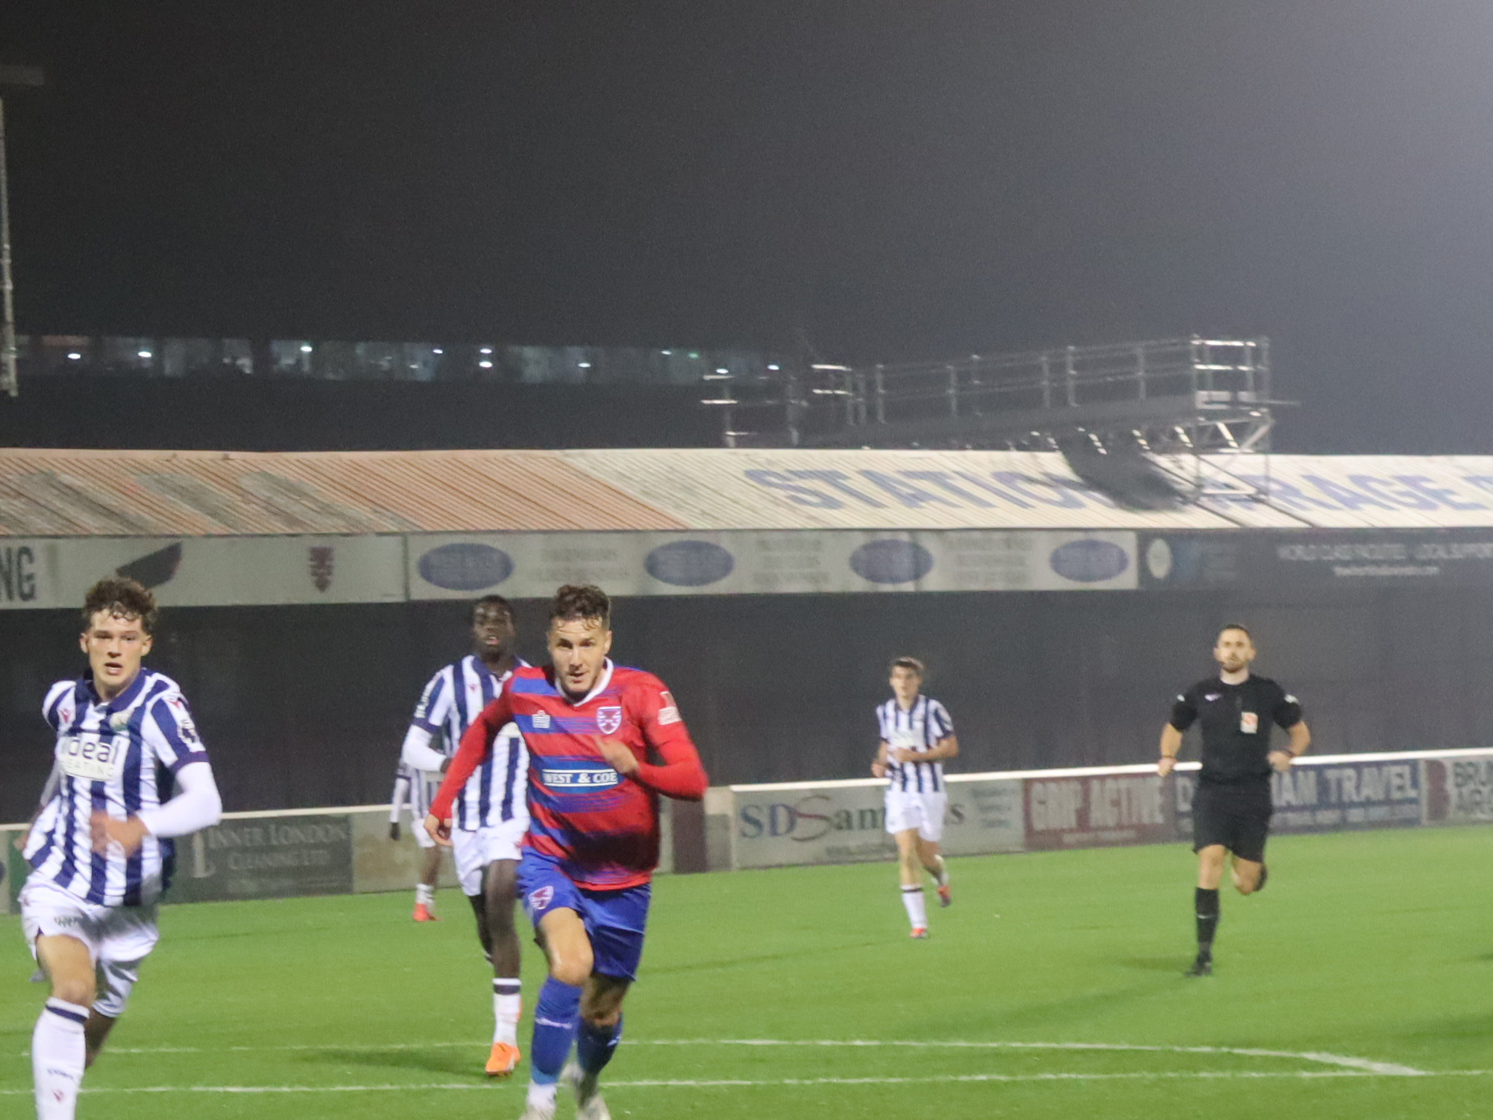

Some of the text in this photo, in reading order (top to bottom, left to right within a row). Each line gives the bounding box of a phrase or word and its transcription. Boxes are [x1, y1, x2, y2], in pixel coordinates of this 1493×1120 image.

[543, 772, 618, 784] WEST & COE
[1325, 765, 1419, 803] TRAVEL
[208, 823, 348, 849] INNER LONDON
